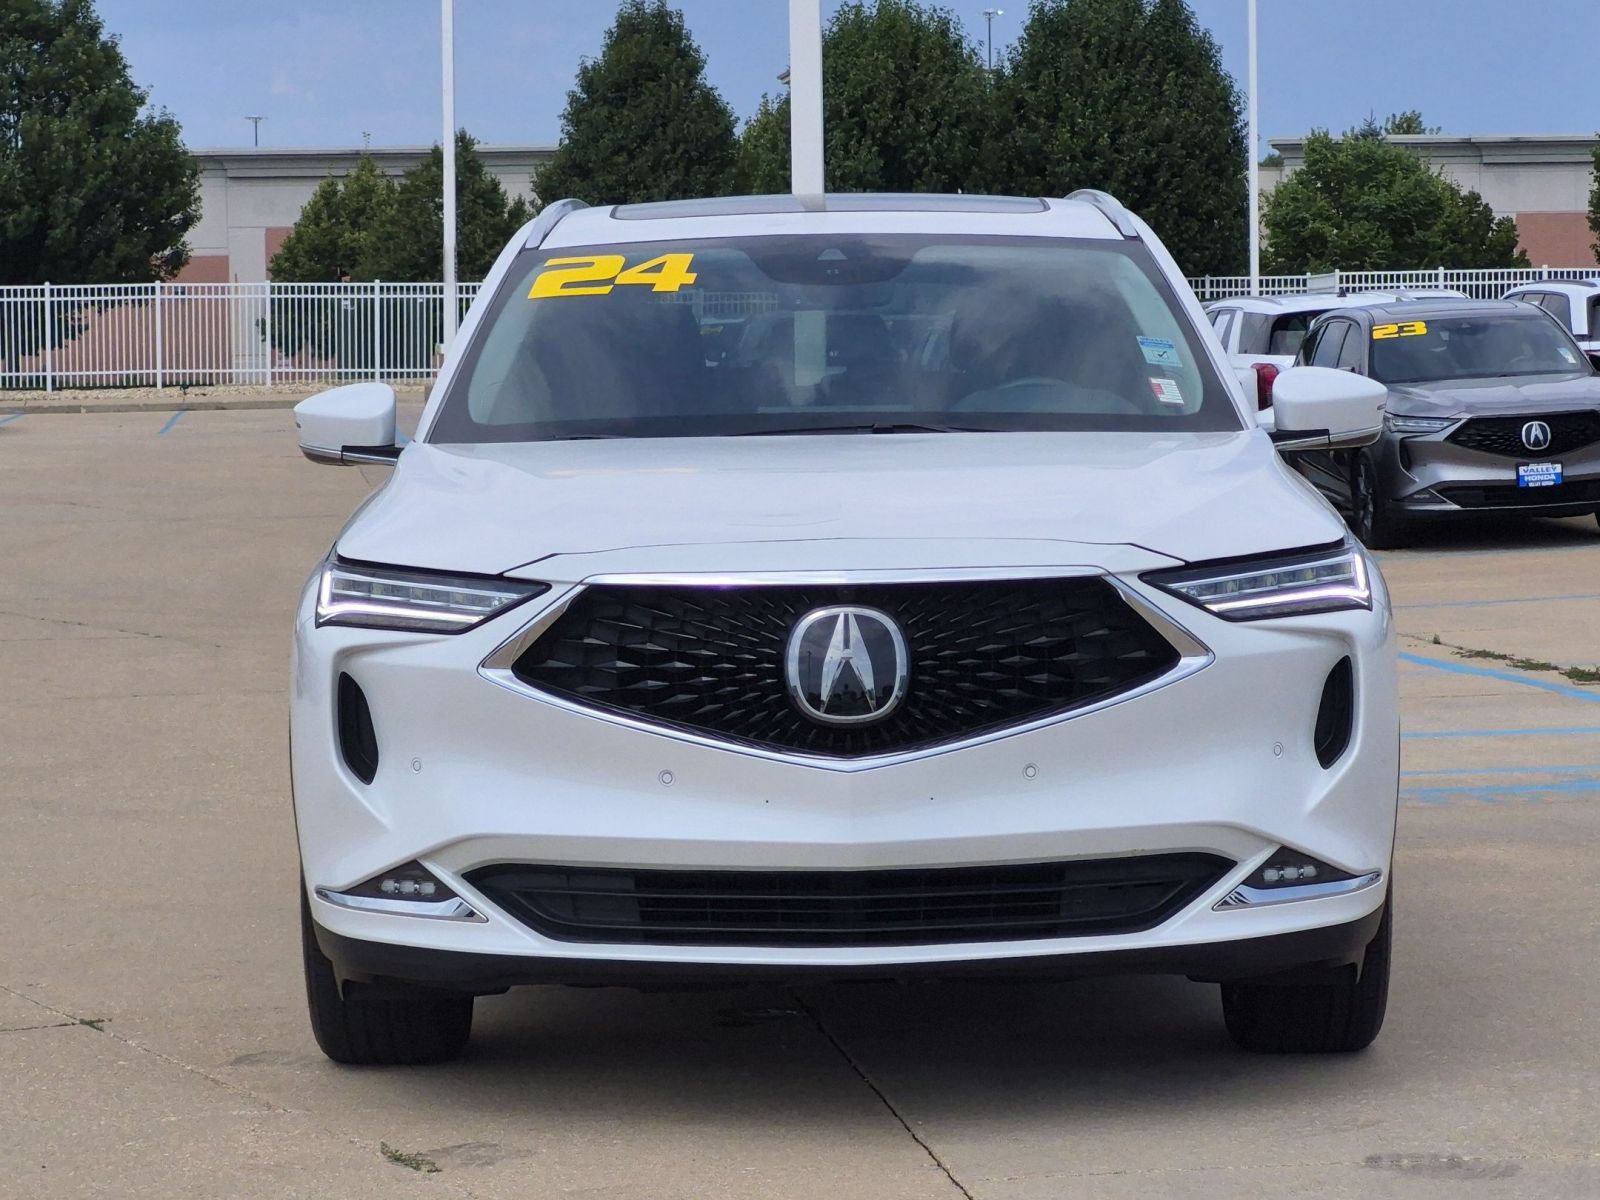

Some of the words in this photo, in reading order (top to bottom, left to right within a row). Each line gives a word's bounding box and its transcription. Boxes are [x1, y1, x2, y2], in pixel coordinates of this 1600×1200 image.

[528, 253, 698, 299] 24
[1372, 321, 1427, 340] 23
[1522, 465, 1557, 473] VALLEY
[1524, 473, 1556, 481] HONDA
